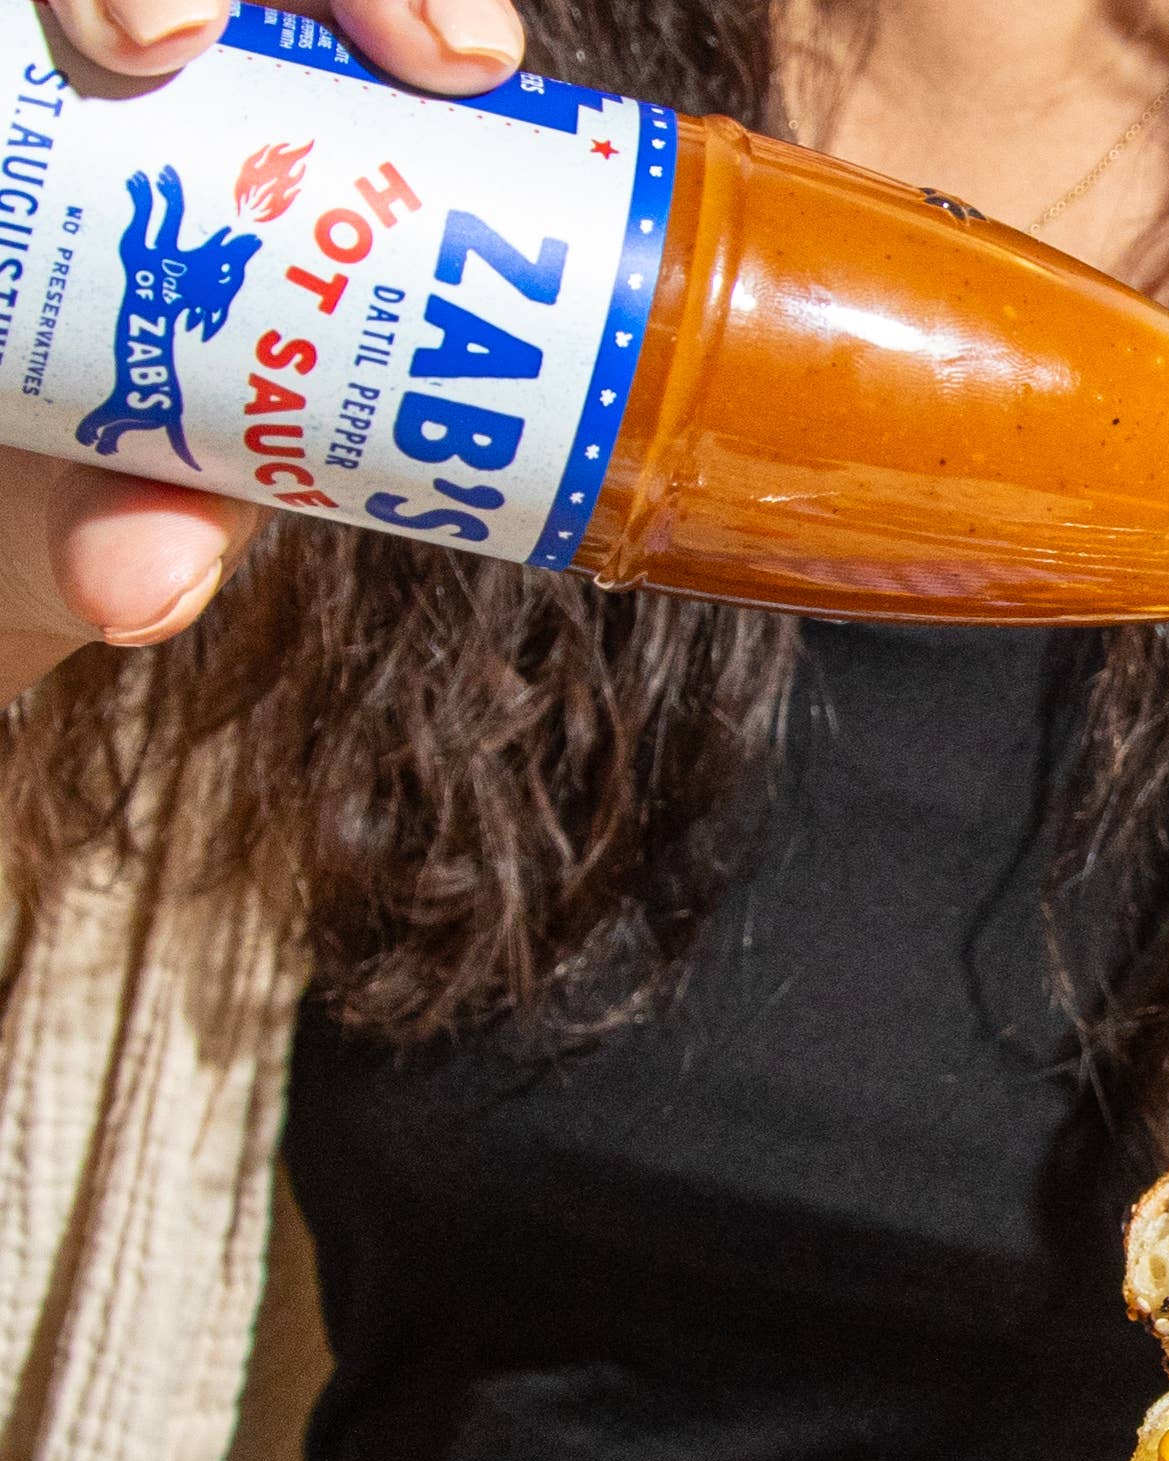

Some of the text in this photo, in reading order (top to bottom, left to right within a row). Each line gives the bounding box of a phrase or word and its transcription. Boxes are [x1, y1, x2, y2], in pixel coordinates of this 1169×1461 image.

[22, 206, 83, 397] NO PRESERVATIVES
[135, 270, 155, 301] OF
[244, 161, 422, 508] HOT SAUCE
[325, 285, 406, 470] DATIL PEPPER
